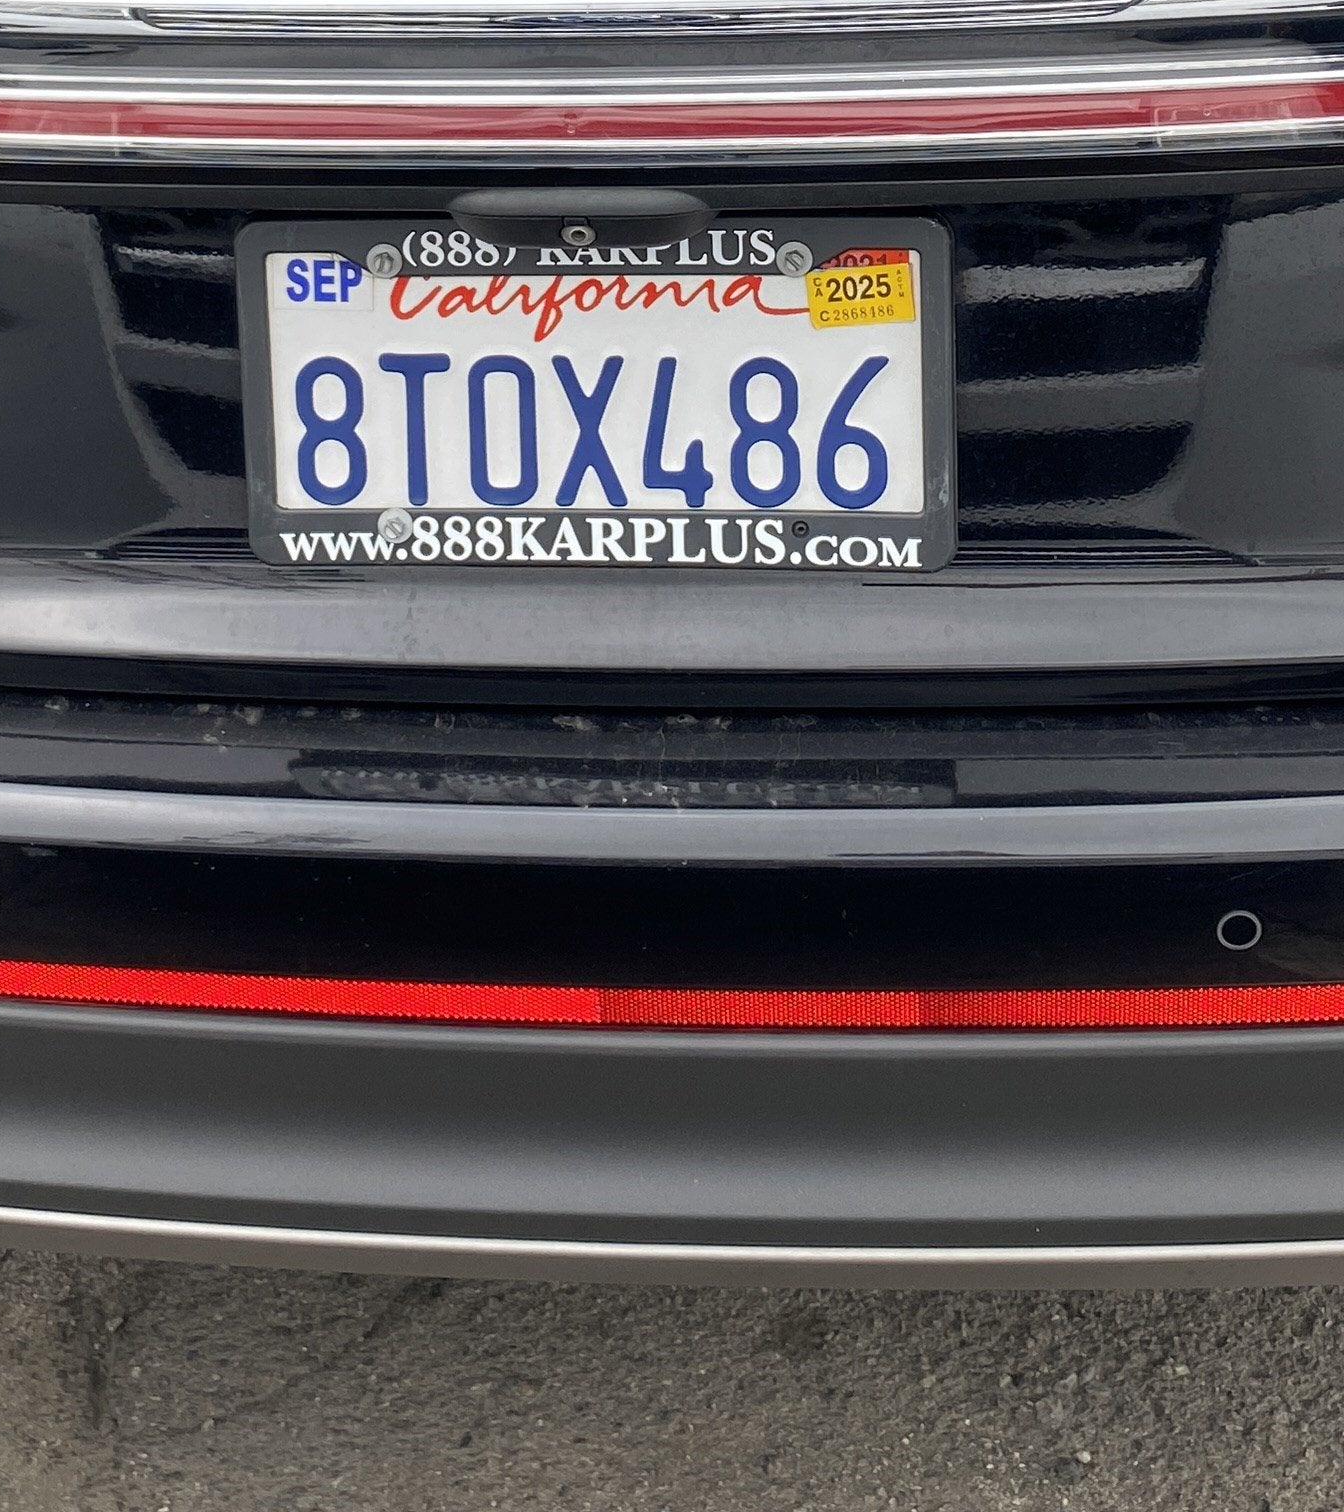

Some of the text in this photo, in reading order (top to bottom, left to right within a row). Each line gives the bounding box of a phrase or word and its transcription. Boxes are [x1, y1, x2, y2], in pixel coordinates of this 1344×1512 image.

[286, 258, 363, 303] SEP
[389, 275, 811, 342] California
[825, 273, 892, 303] 2025
[295, 352, 891, 509] 8TOX486
